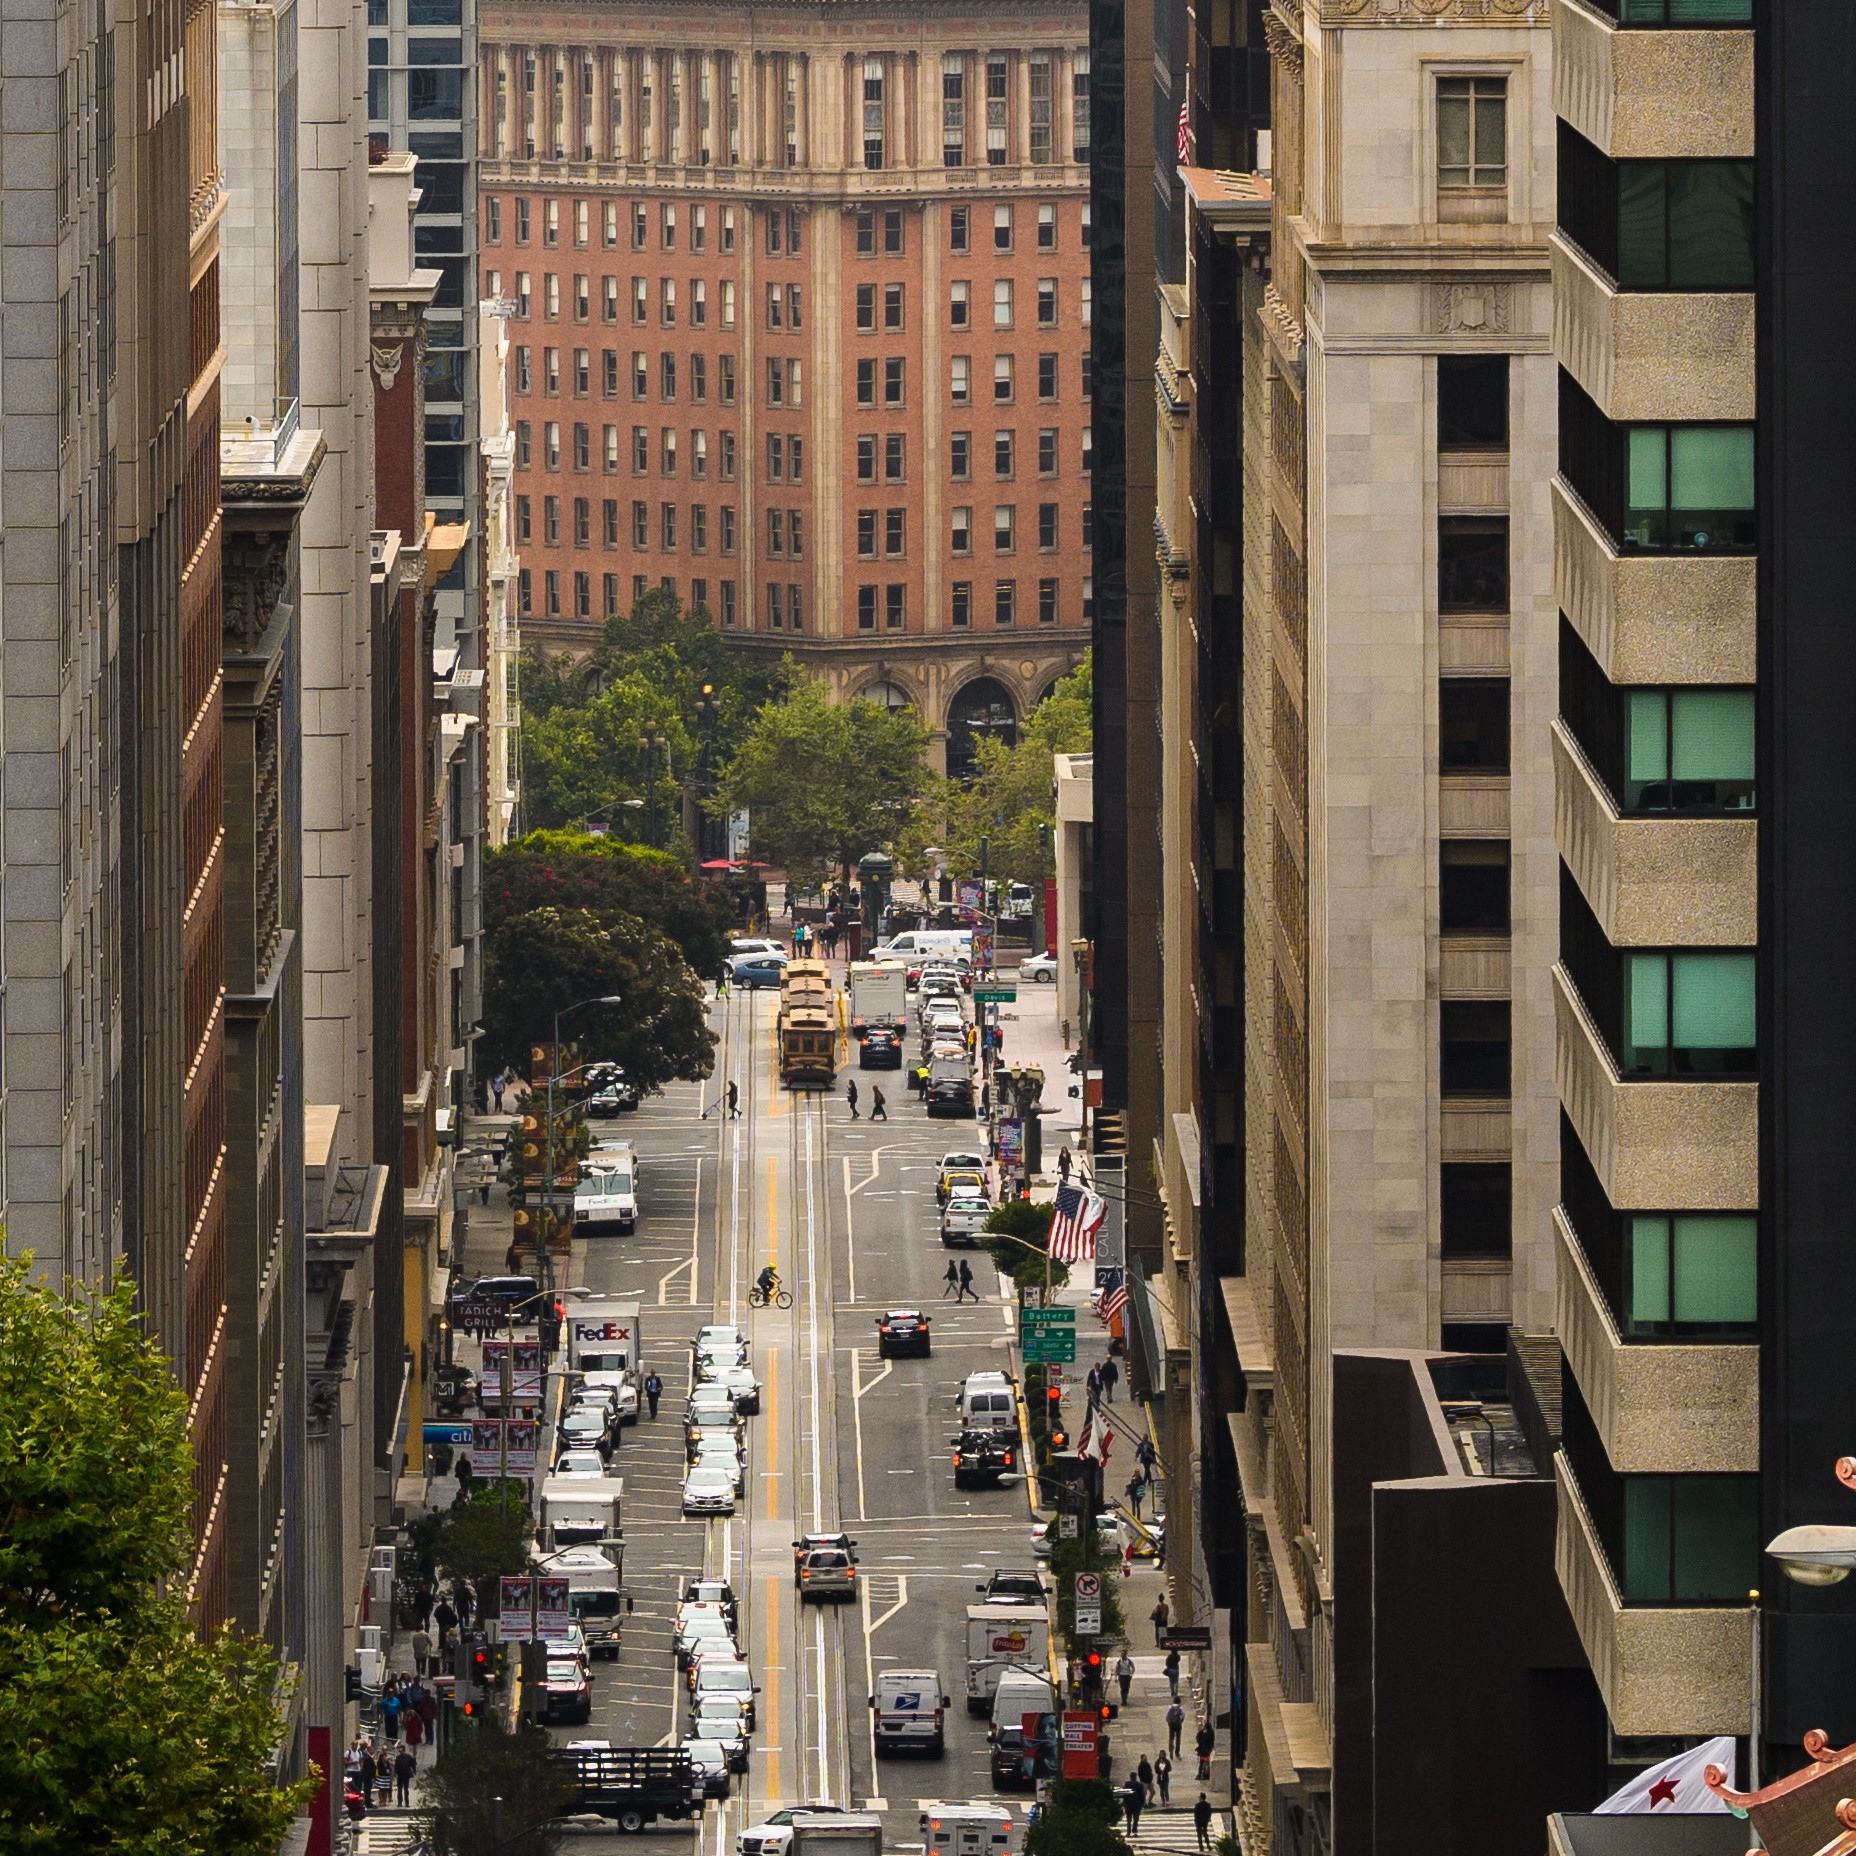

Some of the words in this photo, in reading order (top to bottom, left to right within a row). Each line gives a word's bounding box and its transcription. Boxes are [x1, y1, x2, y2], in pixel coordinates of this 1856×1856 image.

[460, 1306, 502, 1316] TADICH
[1029, 1312, 1069, 1322] Battery
[464, 1318, 496, 1327] GRILL
[575, 1322, 631, 1342] FedEx
[451, 1430, 472, 1442] citi
